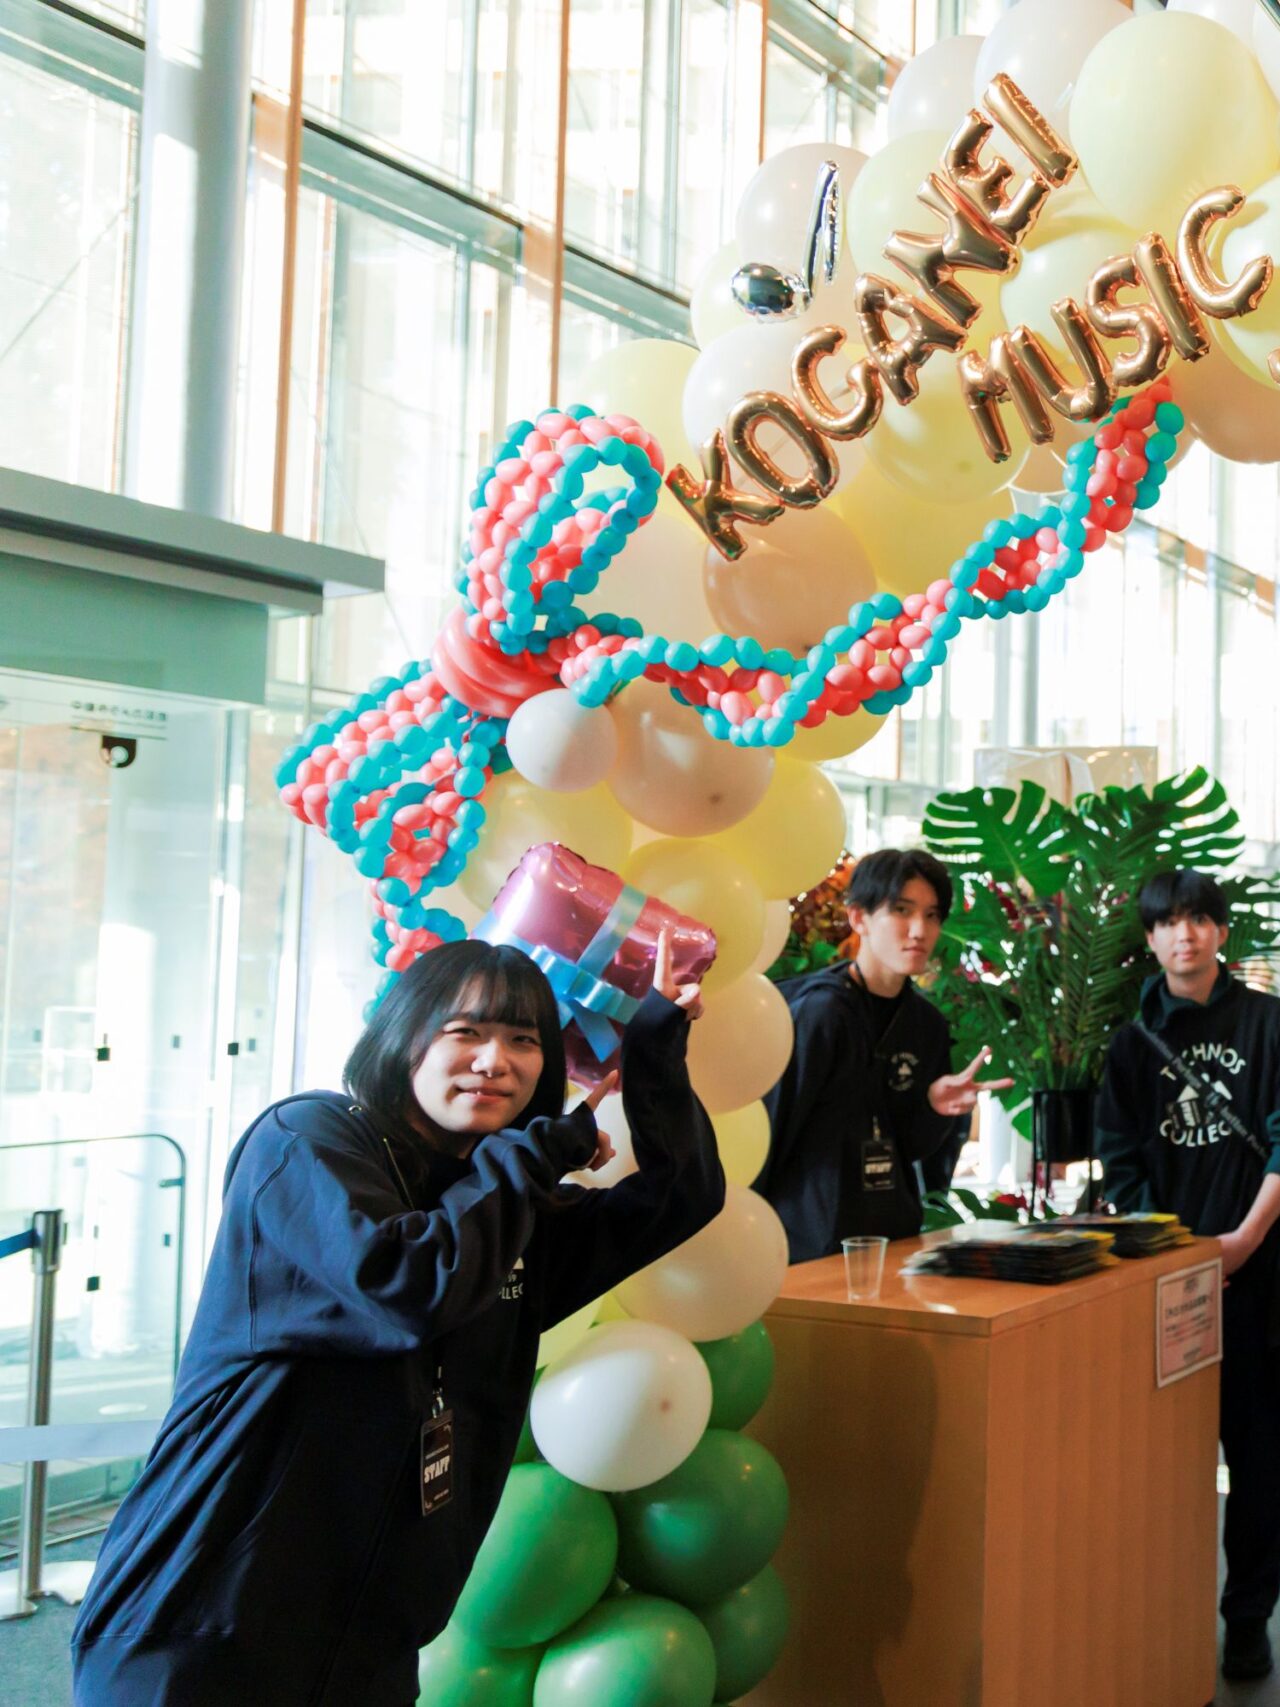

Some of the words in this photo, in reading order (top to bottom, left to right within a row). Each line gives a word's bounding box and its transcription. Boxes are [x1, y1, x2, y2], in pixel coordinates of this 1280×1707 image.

[665, 72, 1079, 562] KOGANEI
[956, 183, 1273, 464] MUSIC
[424, 1455, 451, 1484] STAFF
